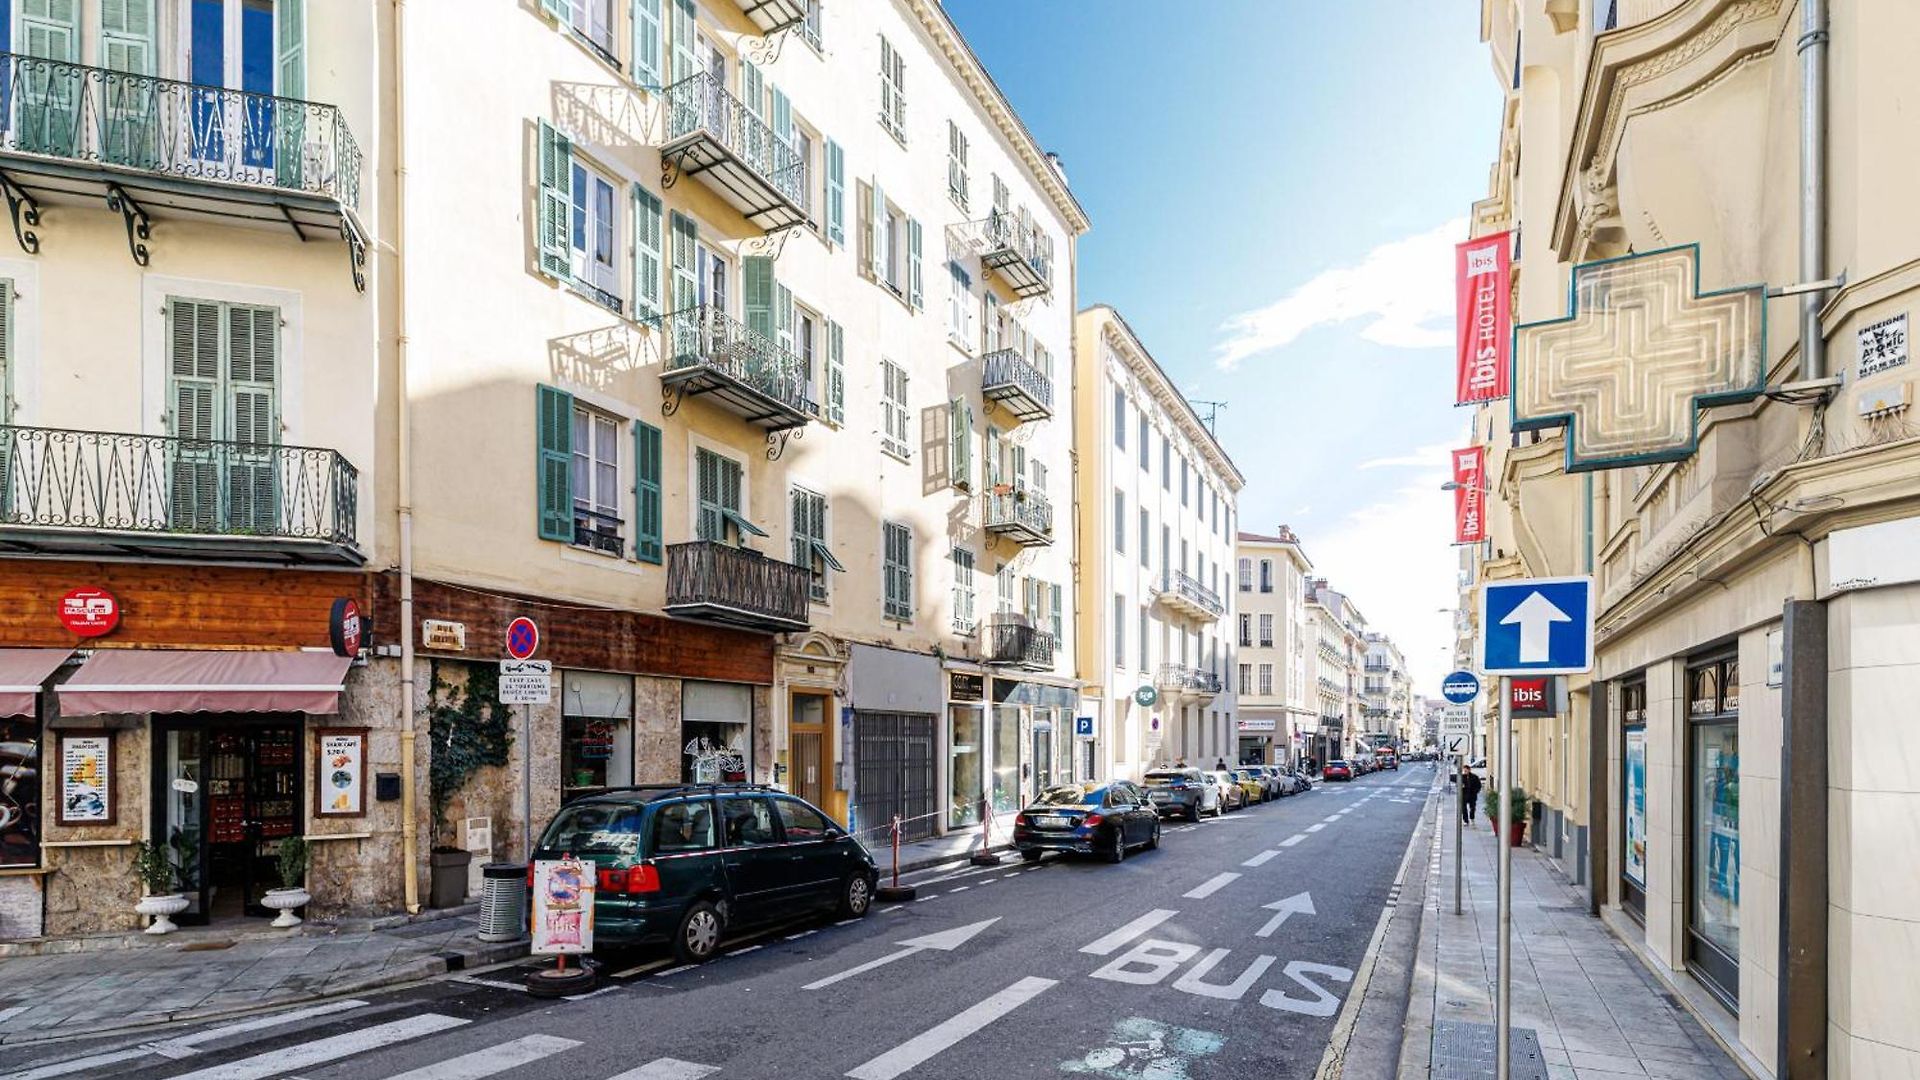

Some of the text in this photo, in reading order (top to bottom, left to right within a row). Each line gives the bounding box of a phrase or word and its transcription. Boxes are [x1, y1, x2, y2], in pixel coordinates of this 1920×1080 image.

[1472, 256, 1493, 269] ibis
[1858, 313, 1906, 336] ENSEIGNE
[1470, 280, 1496, 392] ibis HOTEL
[1463, 510, 1479, 536] ibis
[437, 624, 454, 632] RUE
[1513, 687, 1542, 702] ibis
[1080, 720, 1089, 732] P
[1088, 939, 1354, 1017] BUS
